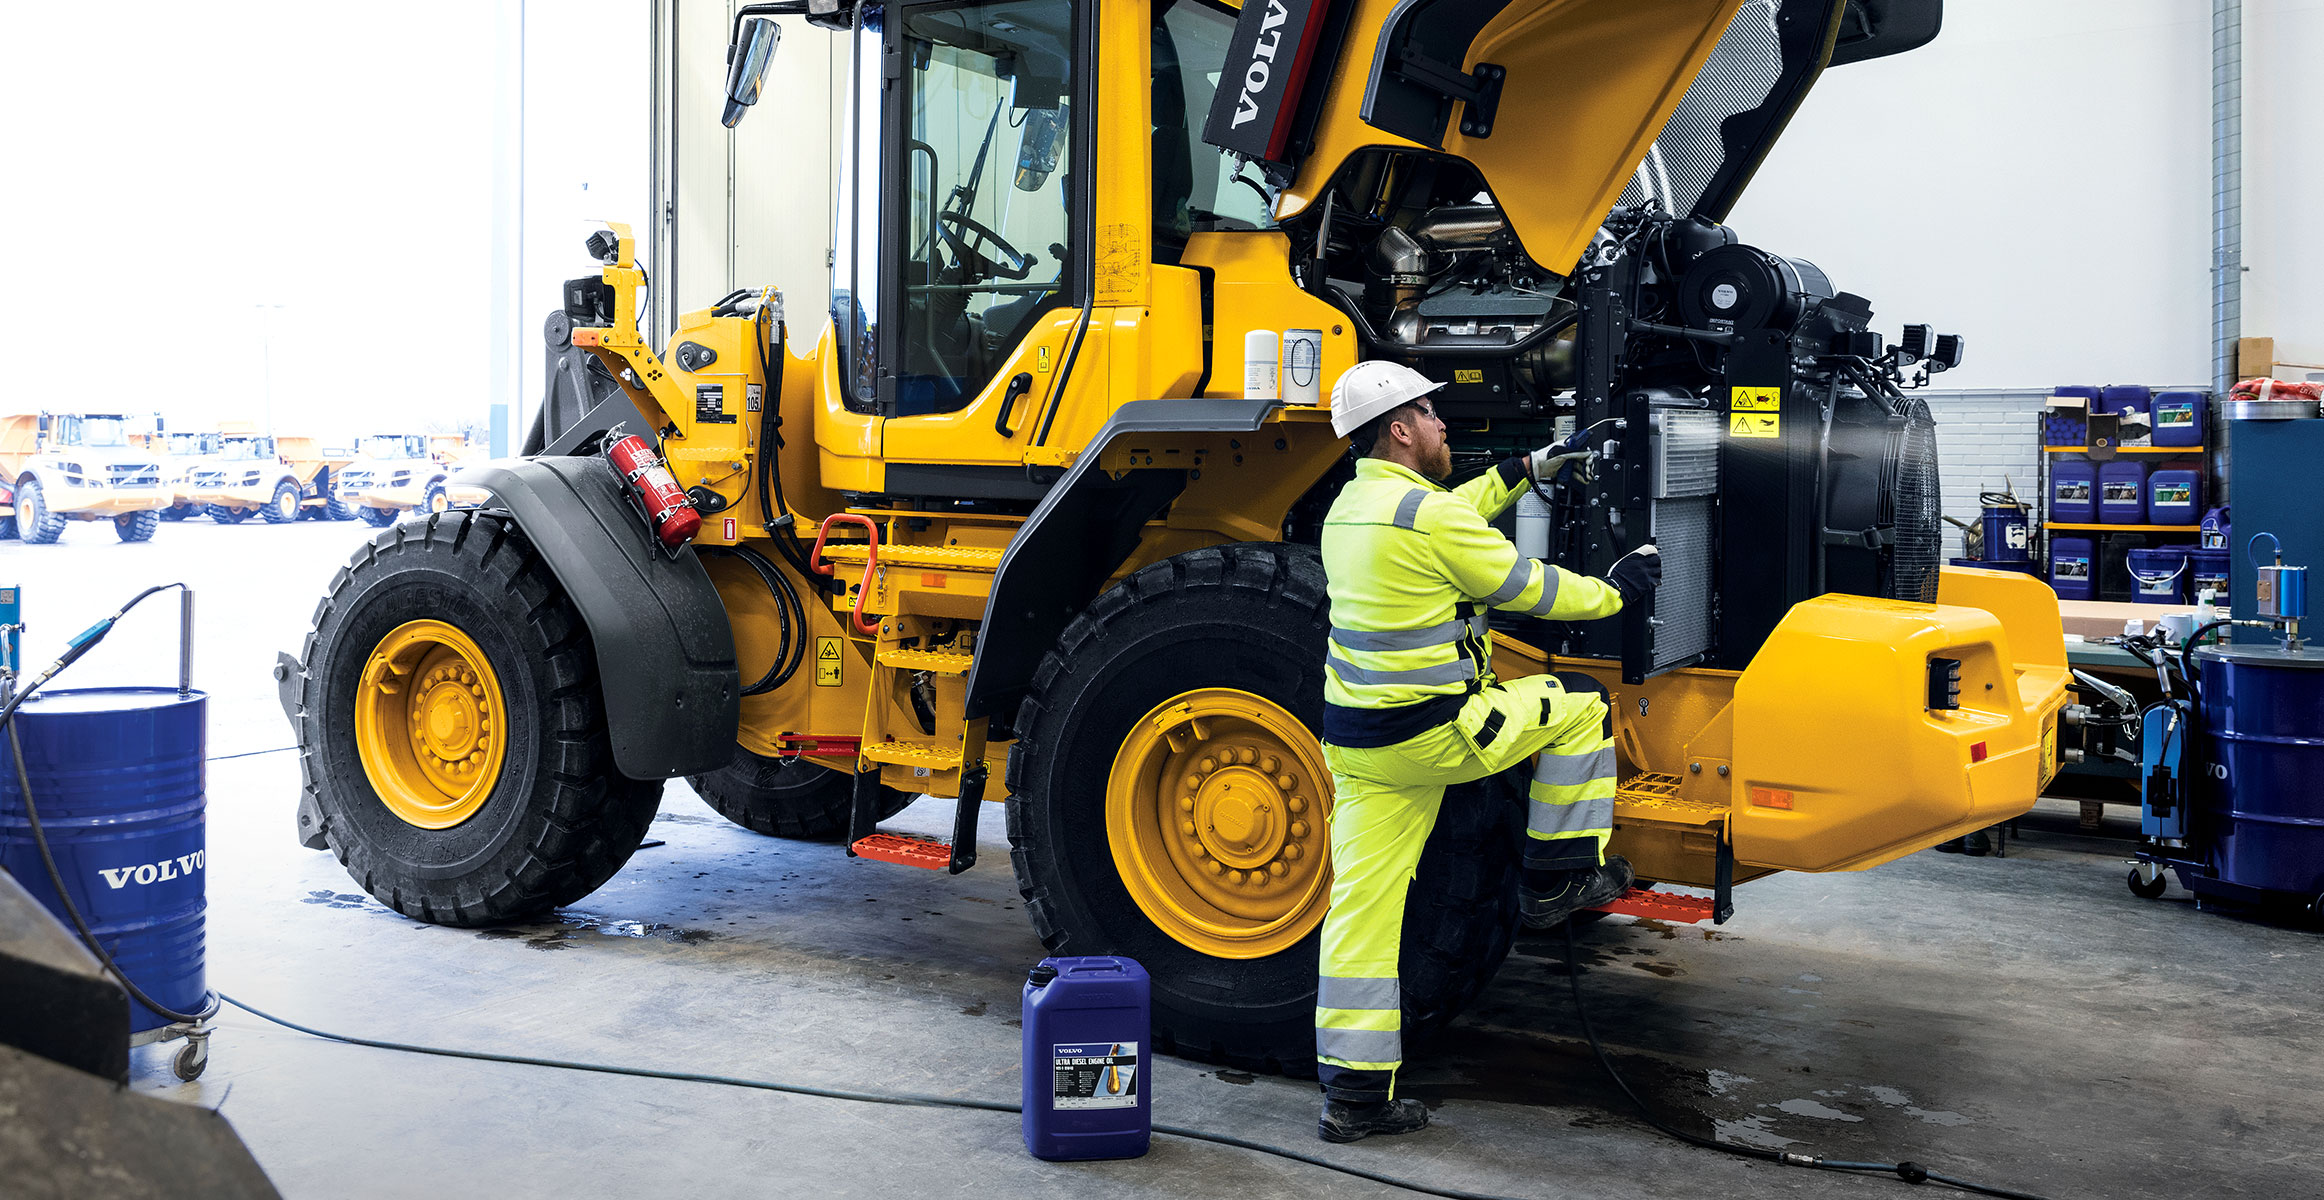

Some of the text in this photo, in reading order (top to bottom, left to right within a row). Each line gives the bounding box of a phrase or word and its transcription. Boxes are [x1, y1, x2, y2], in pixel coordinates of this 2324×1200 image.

[1231, 0, 1289, 130] VOLV
[748, 396, 758, 410] 105
[98, 849, 204, 889] VOLVO
